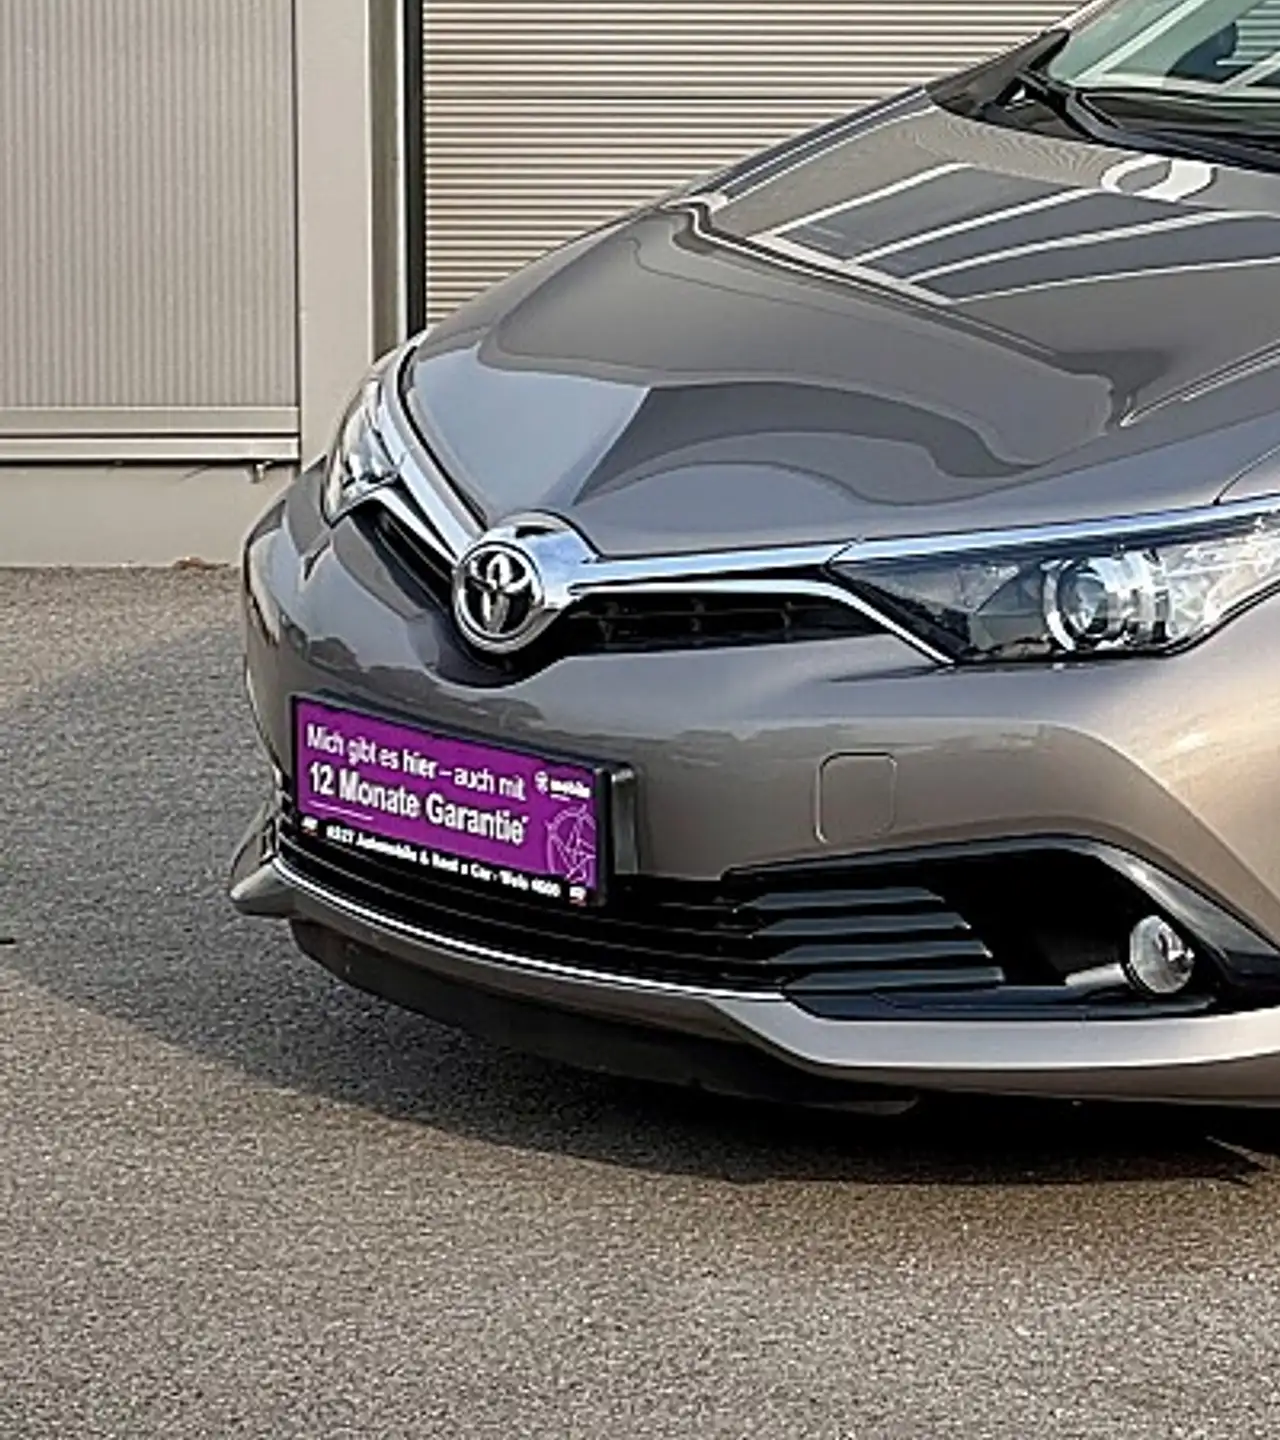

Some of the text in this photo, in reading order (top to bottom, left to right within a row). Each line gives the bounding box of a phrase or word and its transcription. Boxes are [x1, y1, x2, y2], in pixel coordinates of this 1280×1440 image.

[306, 722, 345, 757] Mich
[347, 735, 377, 767] gibt
[378, 747, 399, 770] es
[402, 748, 438, 779] hier
[454, 767, 495, 795] auch
[498, 773, 527, 802] mit
[309, 760, 336, 797] 12
[338, 767, 421, 819] Monate
